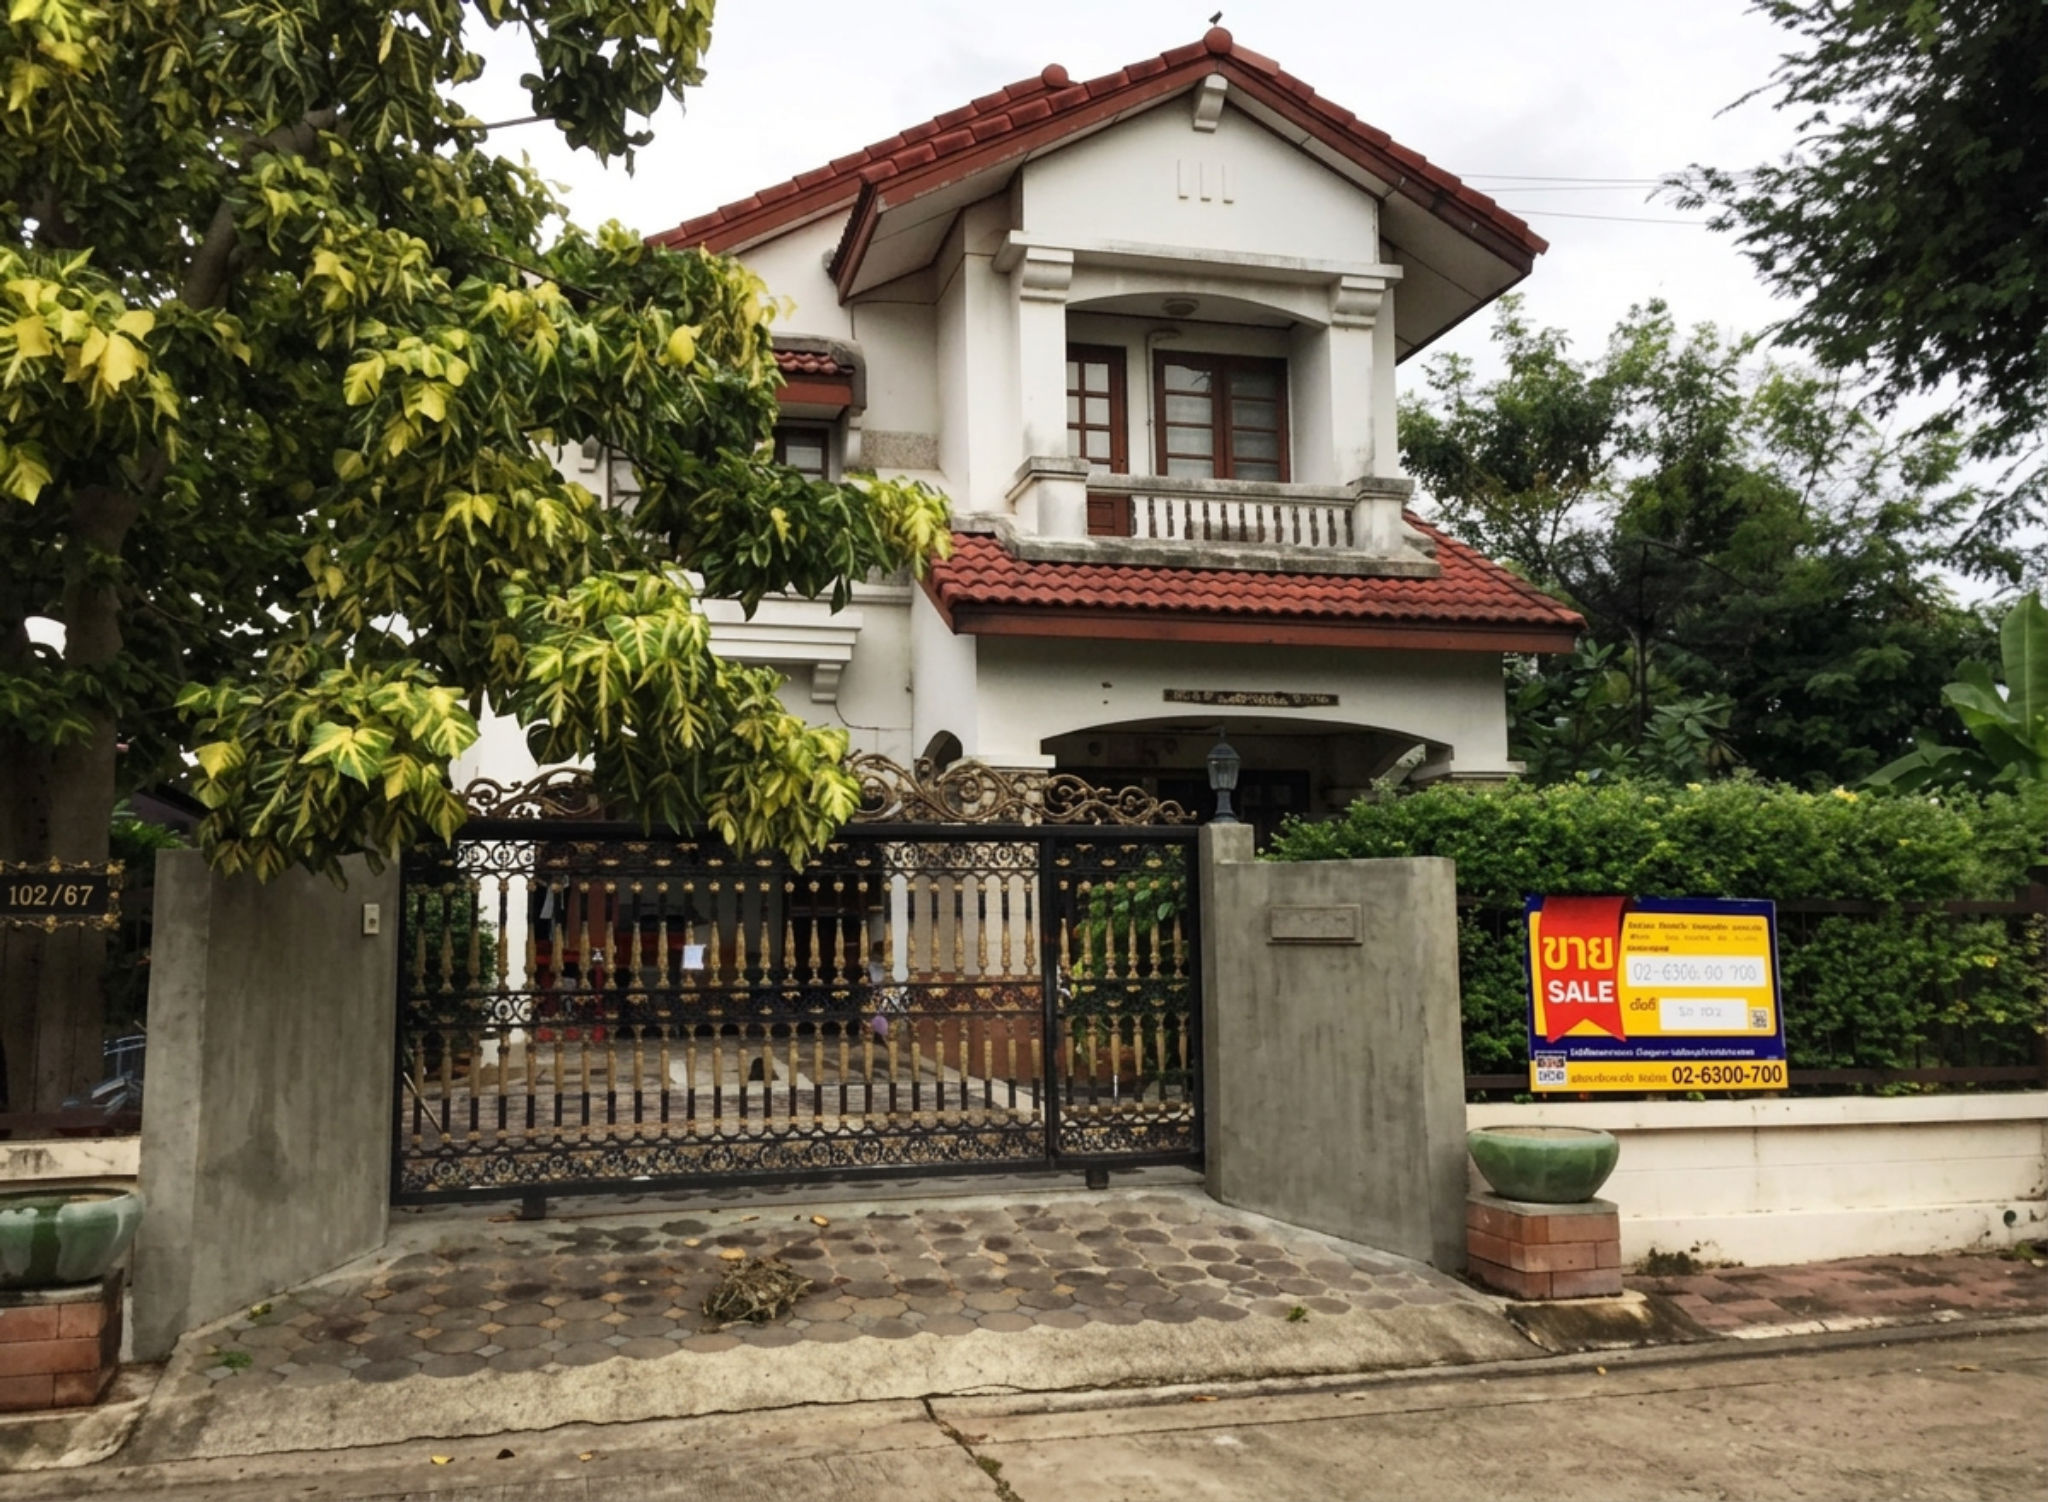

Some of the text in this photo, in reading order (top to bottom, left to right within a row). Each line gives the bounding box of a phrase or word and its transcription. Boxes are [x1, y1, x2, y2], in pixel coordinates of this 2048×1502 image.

[9, 884, 94, 906] 102/67
[1542, 936, 1614, 970] ขาย
[1548, 979, 1615, 1004] SALE
[1672, 1065, 1783, 1085] 02-6300-700
